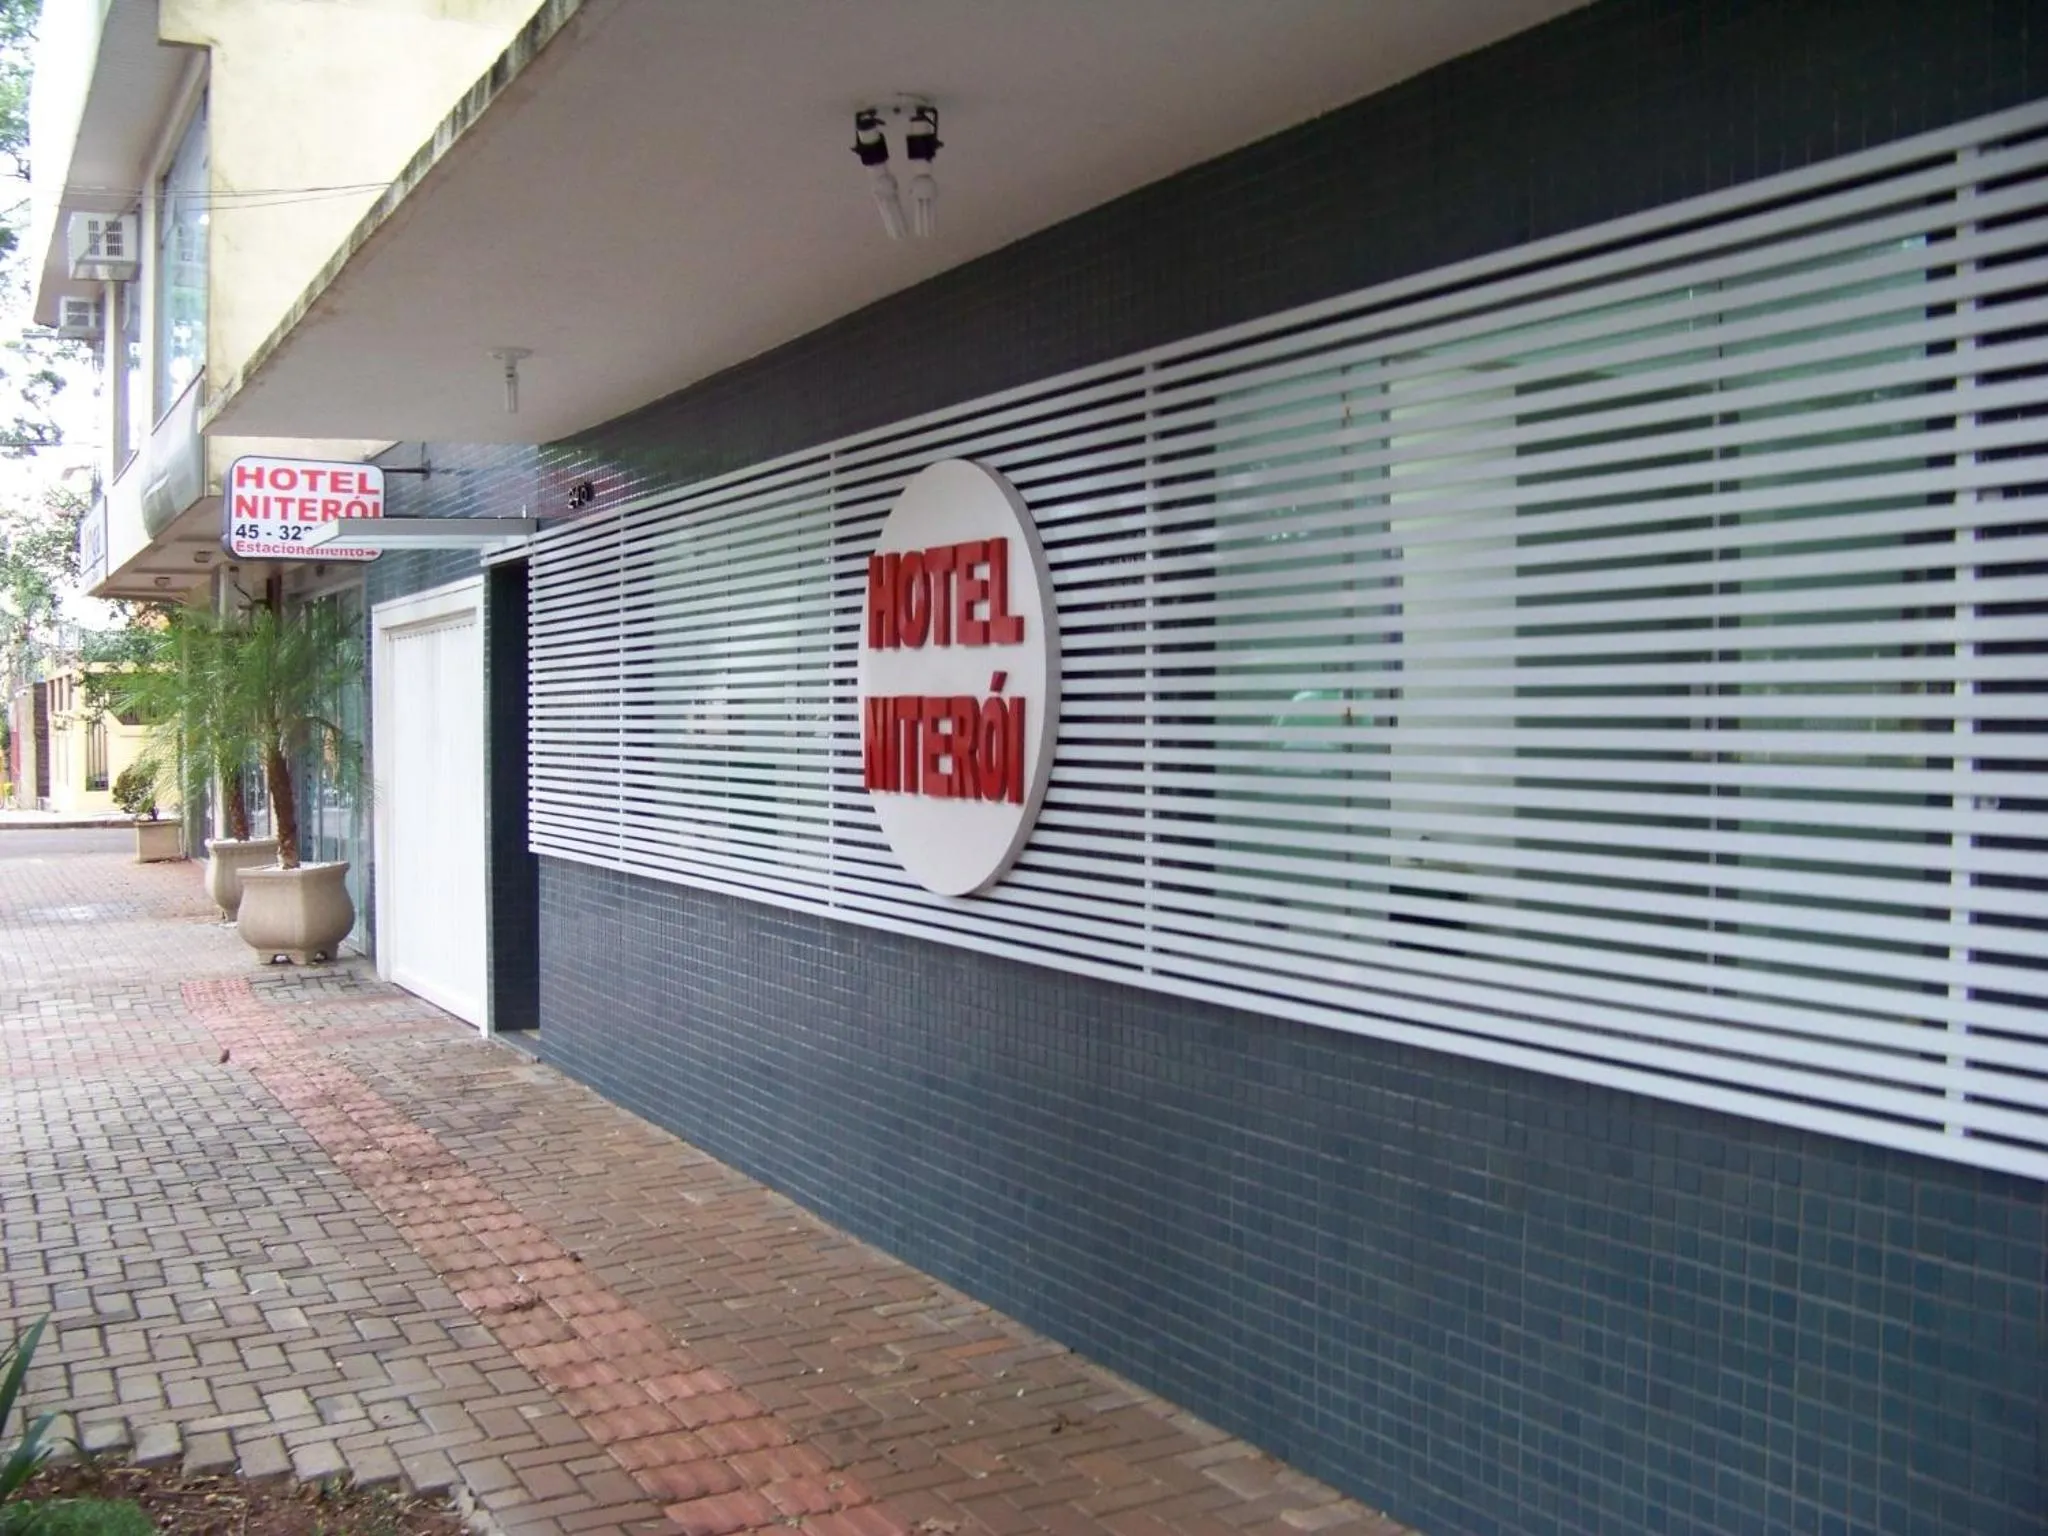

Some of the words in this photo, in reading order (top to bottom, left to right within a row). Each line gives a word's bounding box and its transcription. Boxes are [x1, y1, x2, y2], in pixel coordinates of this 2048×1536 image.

[236, 466, 380, 495] HOTEL
[235, 495, 381, 523] NITERÓI
[235, 524, 259, 539] 45
[236, 540, 364, 557] Estacionamento
[868, 537, 1025, 649] HOTEL
[864, 671, 1027, 805] NITERÓI
